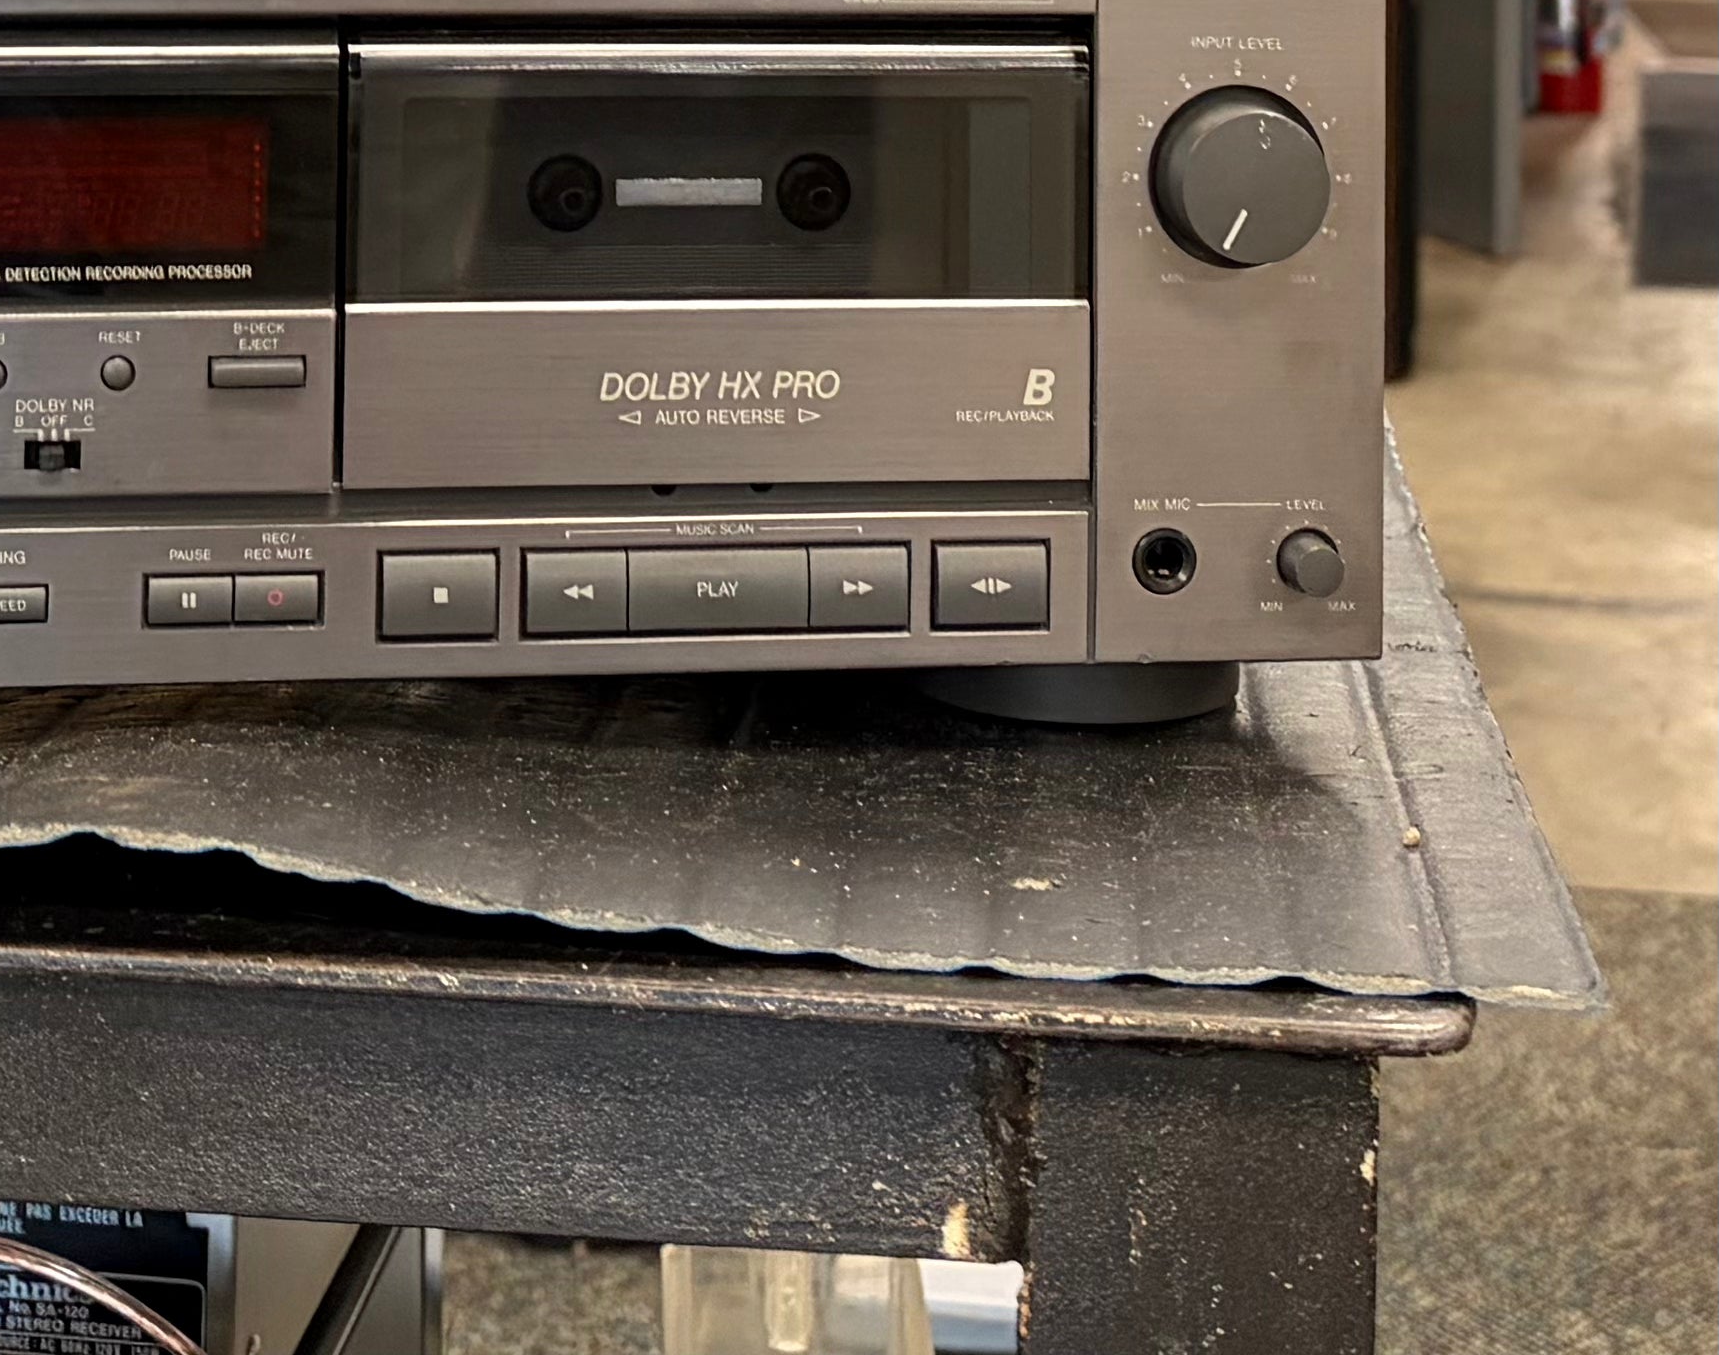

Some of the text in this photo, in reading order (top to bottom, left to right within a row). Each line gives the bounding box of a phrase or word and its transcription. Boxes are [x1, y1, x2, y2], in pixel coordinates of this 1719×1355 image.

[1191, 36, 1285, 51] INPUT LEVEL
[5, 266, 81, 283] DETECTION
[85, 265, 164, 282] RECORDING
[168, 264, 253, 280] PROCESSOR
[98, 330, 141, 344] RESET
[238, 337, 280, 351] EJECT
[600, 369, 841, 402] DOLBY HX PRO
[1023, 369, 1055, 406] B
[15, 398, 95, 413] DOLBY NR
[14, 415, 24, 428] B
[40, 414, 68, 427] OFF
[83, 414, 93, 427] C
[655, 408, 786, 426] AUTO REVERSE
[955, 408, 1055, 423] REC/PLAYBACK
[1133, 497, 1191, 512] MIX MIC
[1285, 499, 1327, 511] LEVEL
[676, 522, 755, 535] MUSIC SCAN
[168, 548, 212, 562] PAUSE
[243, 547, 313, 561] REC MUTE
[696, 580, 738, 598] PLAY
[1259, 601, 1283, 612] MIN
[1328, 601, 1356, 611] MAX
[26, 1202, 52, 1221] PAS
[125, 1211, 144, 1228] LA
[35, 1303, 89, 1319] SA-120
[6, 1317, 65, 1332] STEREO
[70, 1321, 142, 1340] RECEIVER
